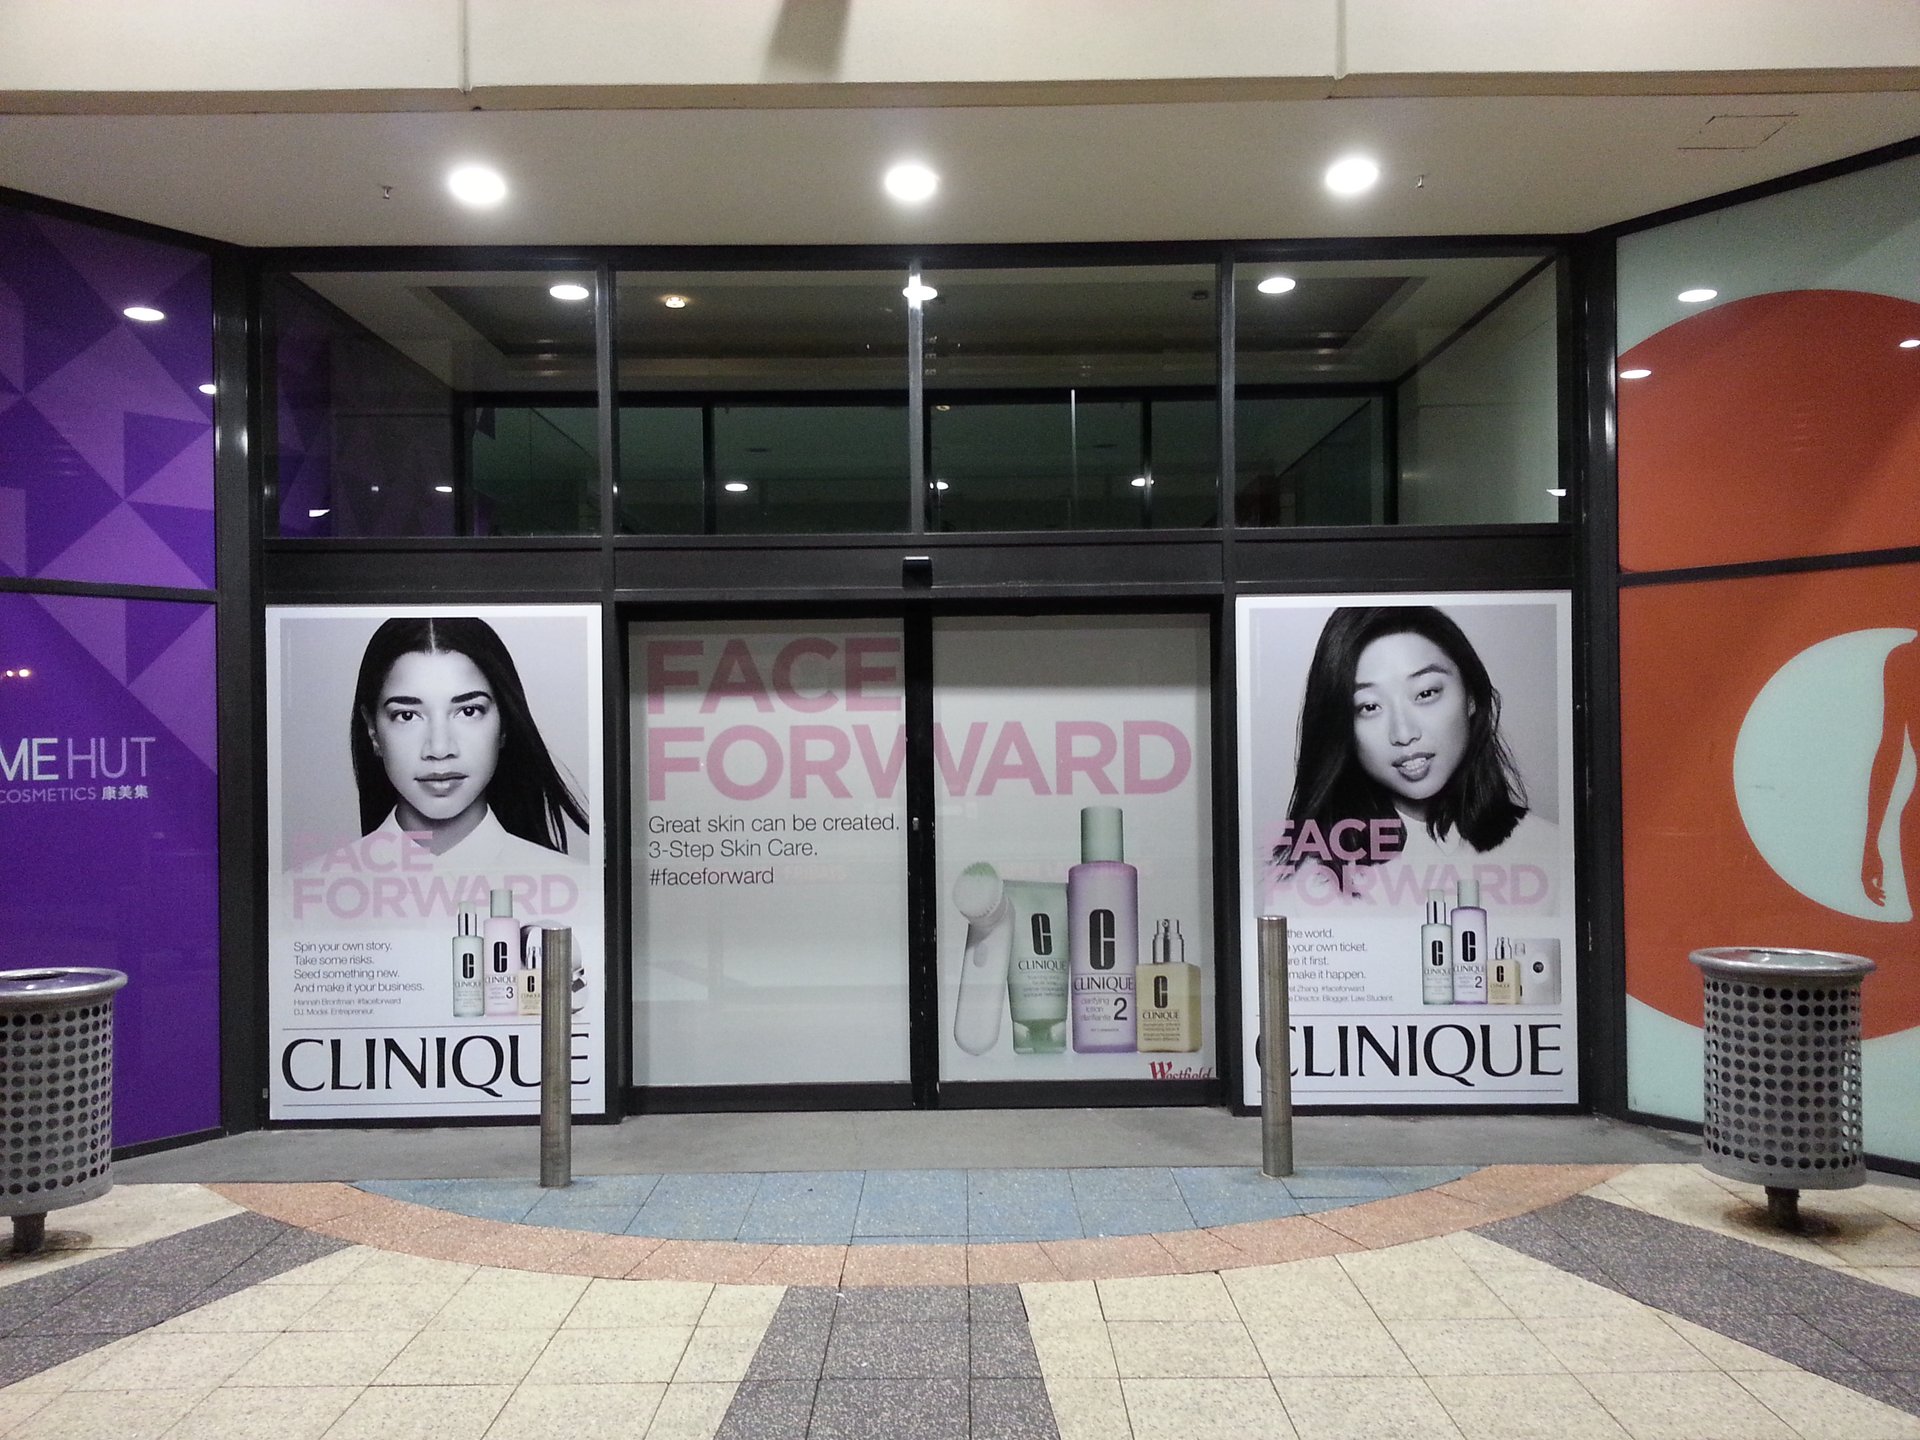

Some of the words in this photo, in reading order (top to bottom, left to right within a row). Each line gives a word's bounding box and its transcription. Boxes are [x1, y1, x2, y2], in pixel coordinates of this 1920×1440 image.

[648, 637, 903, 715] FACE
[648, 815, 701, 833] Great
[707, 814, 745, 832] skin
[751, 818, 786, 831] can
[793, 814, 817, 831] be
[822, 813, 900, 831] created.
[1264, 818, 1404, 862] FACE
[292, 830, 433, 874] FACE
[648, 839, 714, 861] 3-Step
[720, 839, 761, 857] Skin
[767, 838, 818, 857] Care.
[649, 867, 774, 886] #faceforward
[1265, 863, 1550, 908] FORWARD
[293, 874, 579, 920] FORWARD
[1304, 929, 1334, 939] world.
[294, 942, 317, 954] Spin
[318, 943, 340, 954] your
[342, 943, 364, 951] own
[366, 941, 392, 952] story.
[1292, 943, 1314, 953] your
[1316, 943, 1337, 952] own
[1340, 942, 1367, 952] ticket.
[294, 955, 317, 966] Take
[319, 956, 347, 965] some
[349, 955, 375, 965] risks.
[1018, 960, 1067, 971] CLINIQUE
[1301, 957, 1307, 966] it
[1309, 956, 1329, 966] first.
[294, 969, 320, 979] Seed
[322, 969, 374, 980] something
[376, 970, 400, 978] new.
[1289, 970, 1316, 980] make
[1318, 970, 1324, 979] it
[1326, 969, 1366, 981] happen.
[294, 983, 314, 993] And
[317, 983, 345, 992] make
[346, 983, 352, 992] it
[354, 984, 377, 994] your
[378, 982, 425, 992] business.
[1074, 977, 1134, 992] CLINIQUE
[1474, 976, 1483, 989] 2
[506, 986, 514, 999] 3
[1113, 997, 1128, 1021] 2
[1142, 1011, 1179, 1021] CLINIQUE
